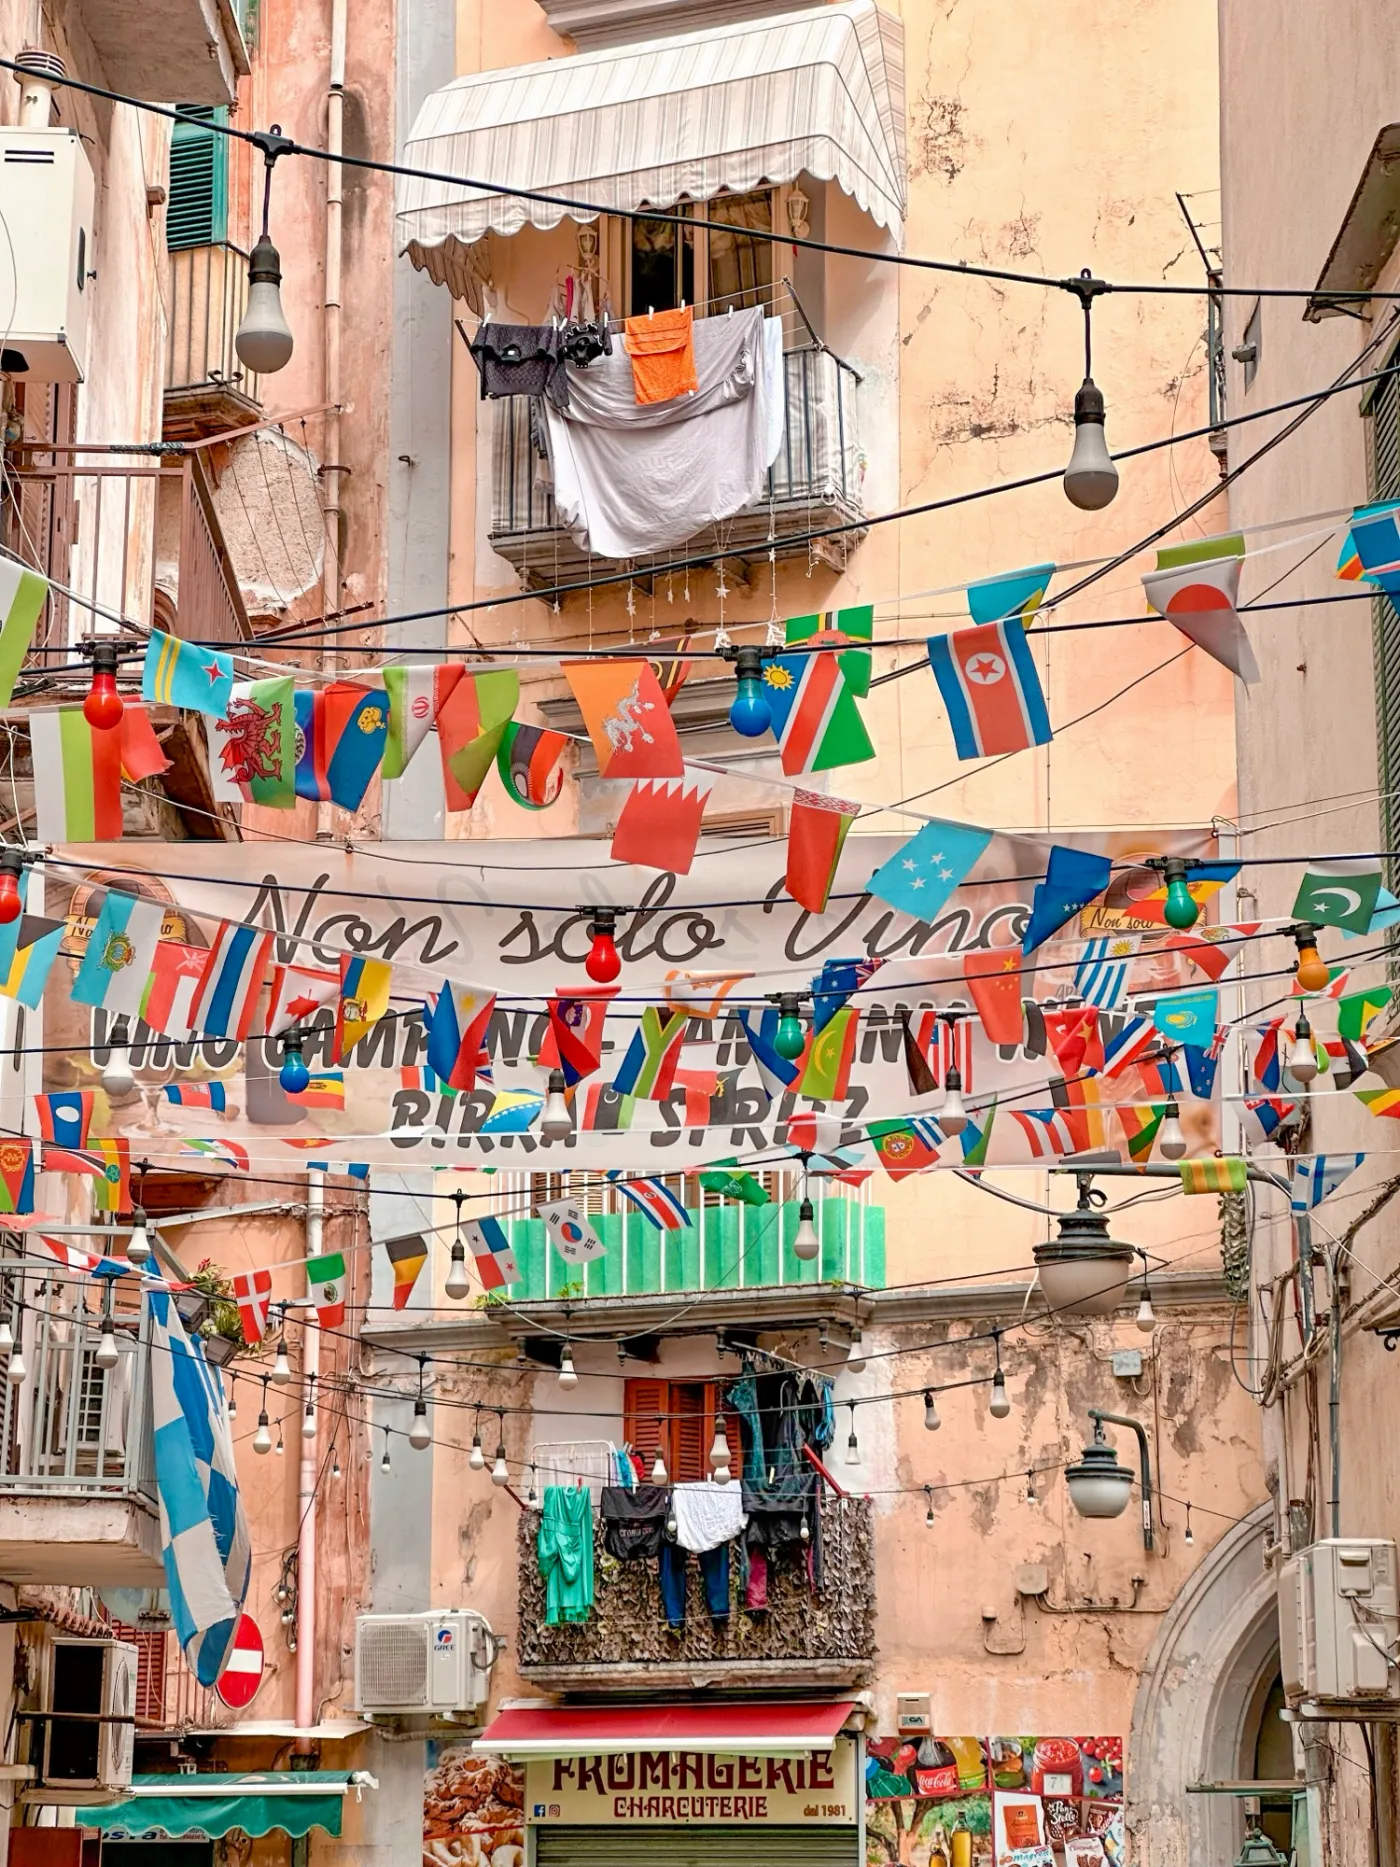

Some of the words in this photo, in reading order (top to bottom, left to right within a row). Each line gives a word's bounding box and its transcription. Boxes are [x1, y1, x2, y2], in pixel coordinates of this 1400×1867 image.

[243, 873, 459, 964] Non
[498, 871, 726, 963] solo
[763, 868, 1033, 962] Vino
[1090, 908, 1121, 928] Non
[552, 1750, 834, 1795] FROMAGERIE
[613, 1796, 768, 1821] CHARCUTERIE
[803, 1804, 819, 1817] dal
[821, 1804, 847, 1817] 1981
